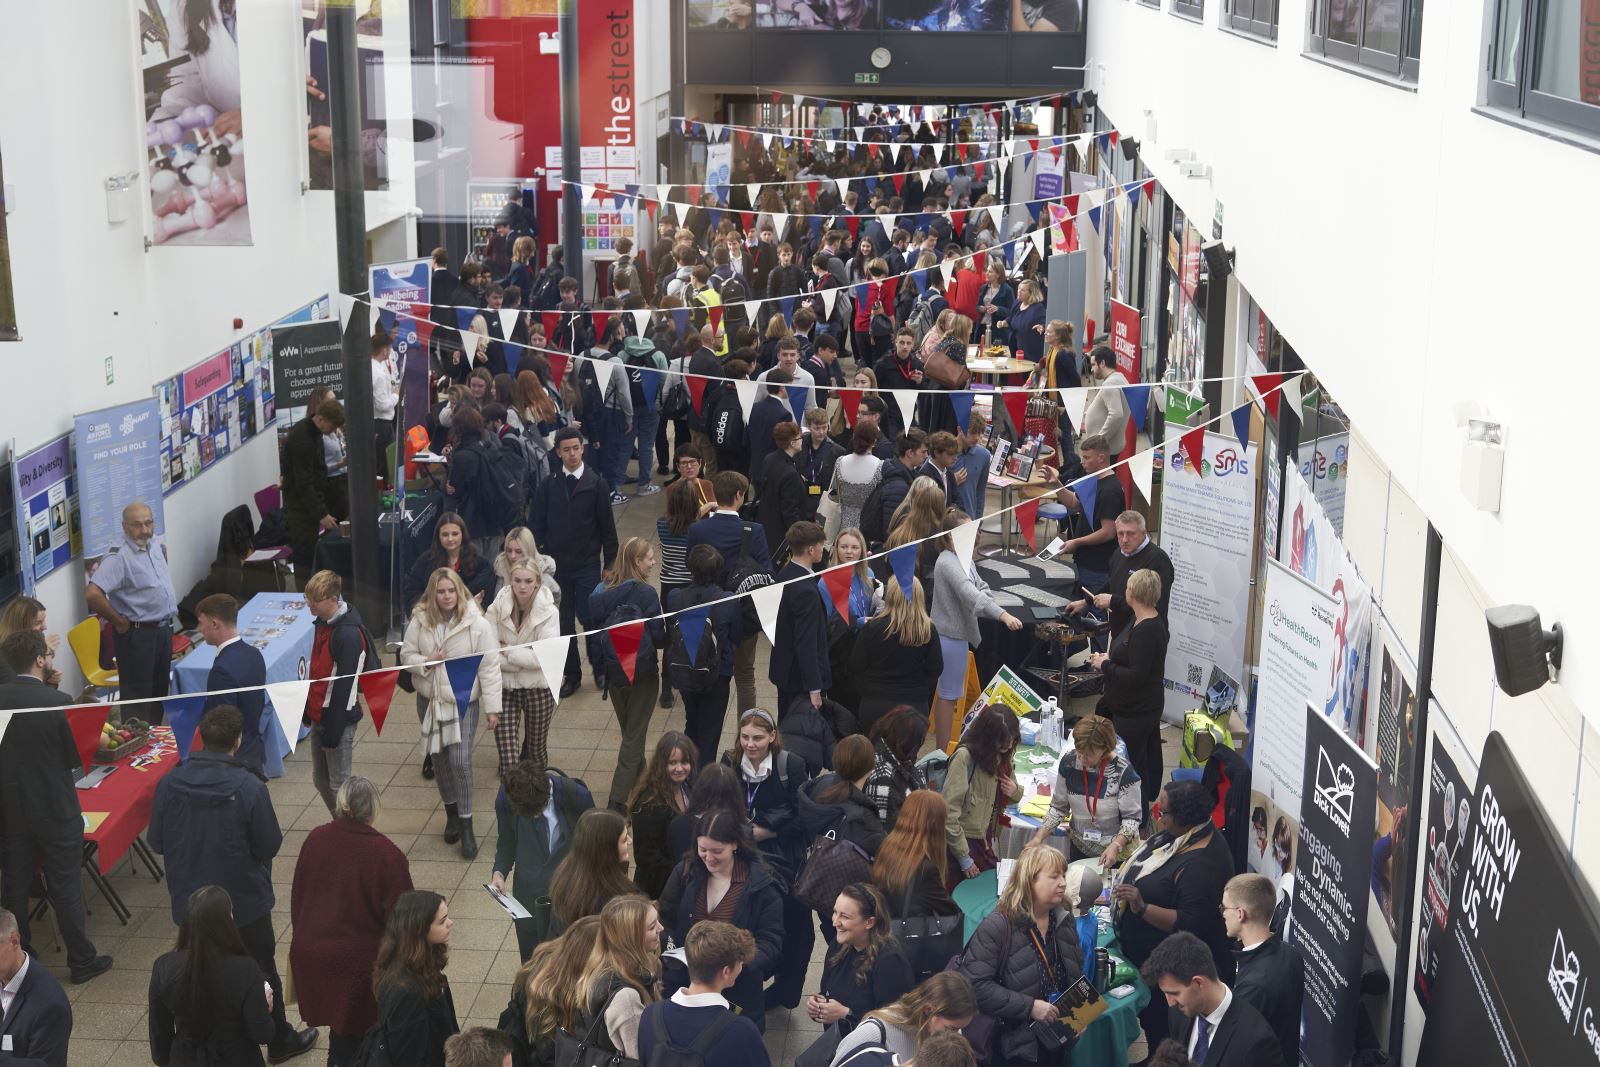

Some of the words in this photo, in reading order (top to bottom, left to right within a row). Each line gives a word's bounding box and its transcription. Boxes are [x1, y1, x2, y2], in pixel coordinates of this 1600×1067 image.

[380, 288, 419, 301] Wellbeing
[284, 368, 297, 377] For
[305, 365, 323, 376] great
[290, 378, 316, 387] choose
[322, 373, 342, 383] great
[716, 411, 729, 444] adidas
[33, 468, 38, 479] &
[39, 456, 63, 476] Diversity
[94, 450, 109, 461] FIND
[110, 445, 128, 456] YOUR
[129, 440, 148, 450] ROLE
[1282, 612, 1321, 649] HealthReach
[1303, 655, 1318, 671] Health
[1016, 685, 1031, 698] SAFETY
[1313, 789, 1329, 816] Dick
[1329, 808, 1350, 839] Lovett
[1299, 815, 1343, 883] Engaging.
[1479, 783, 1521, 883] GROW
[1312, 855, 1356, 924] Dynamic.
[1471, 824, 1506, 922] WITH
[1296, 865, 1312, 892] We're
[1311, 886, 1322, 903] not
[1320, 894, 1332, 917] just
[1332, 908, 1350, 941] talking
[1299, 889, 1317, 914] about
[1316, 908, 1327, 924] our
[1461, 869, 1481, 939] US.
[1547, 967, 1558, 997] Dick
[1556, 987, 1571, 1024] Lovett
